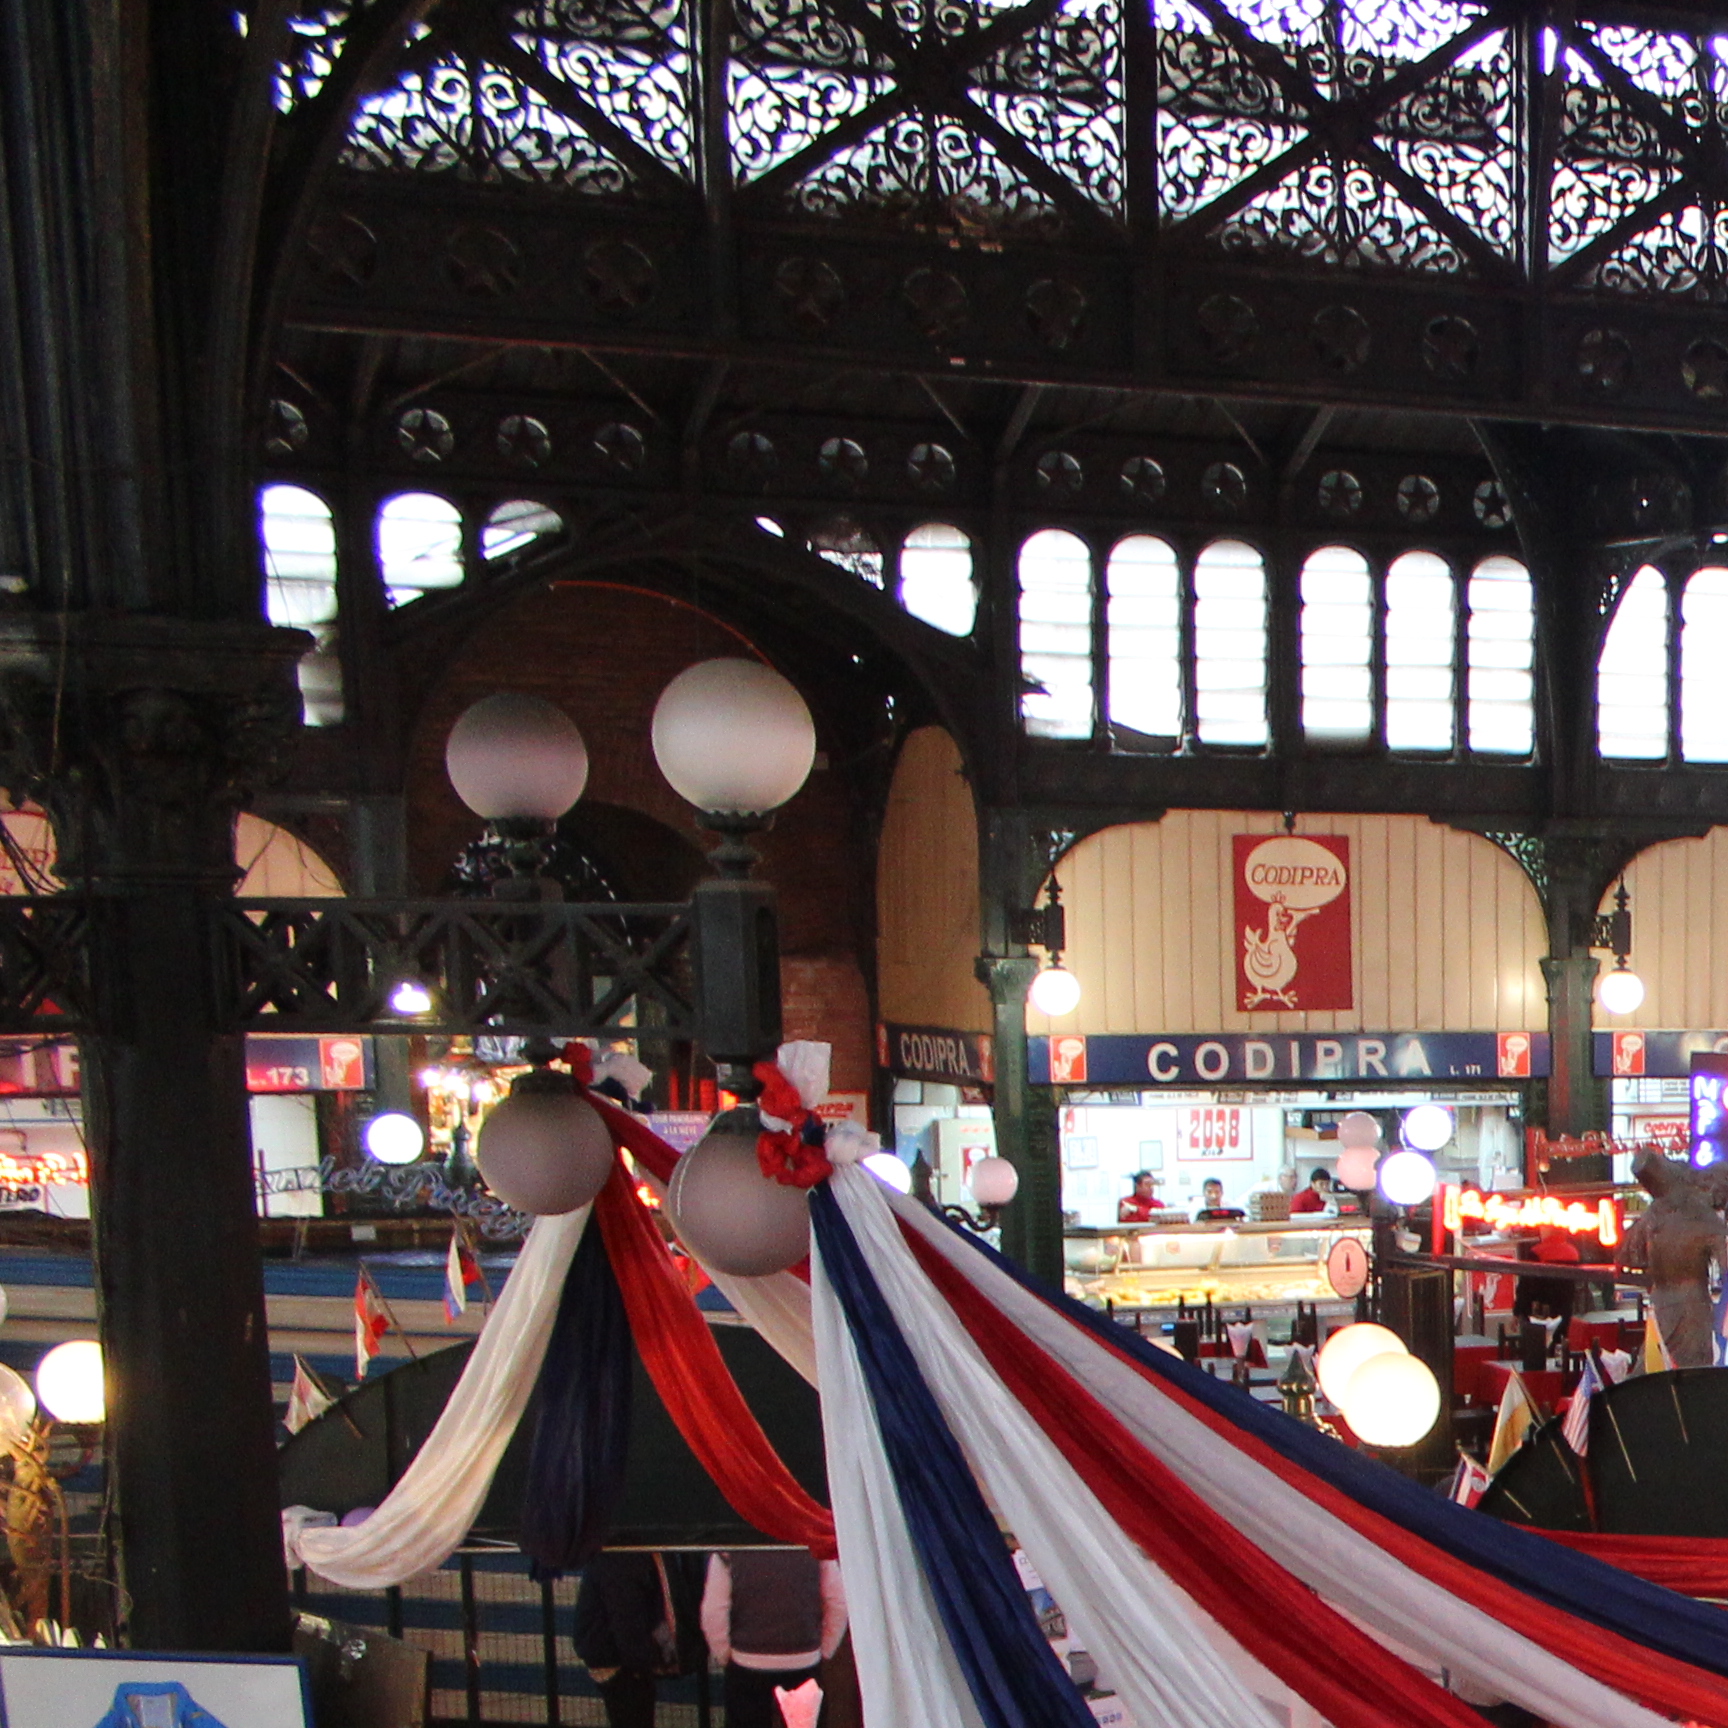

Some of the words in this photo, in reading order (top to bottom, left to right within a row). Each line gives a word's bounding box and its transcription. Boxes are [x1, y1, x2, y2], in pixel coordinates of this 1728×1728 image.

[1251, 863, 1340, 888] CODIPRA
[899, 1032, 972, 1076] CODIPRA
[1147, 1040, 1431, 1081] CODIPRA
[268, 1067, 310, 1086] 173
[1190, 1109, 1240, 1148] 2038
